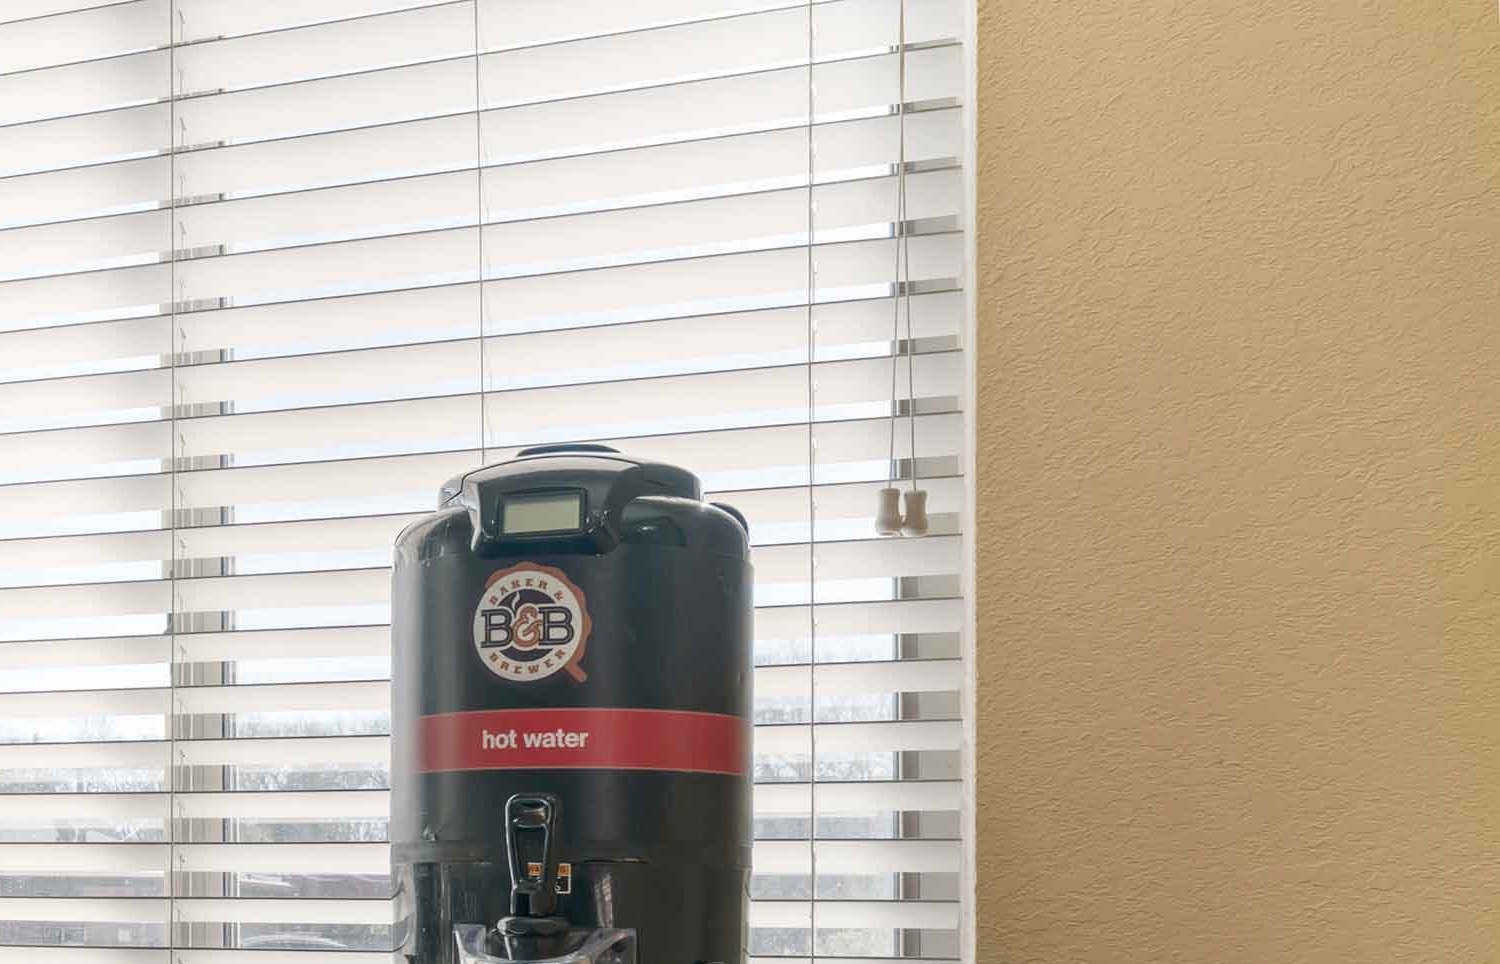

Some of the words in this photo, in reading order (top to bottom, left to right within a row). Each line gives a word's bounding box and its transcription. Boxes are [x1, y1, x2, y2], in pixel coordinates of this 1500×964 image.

[481, 606, 574, 648] B&B
[482, 729, 518, 750] hot
[523, 728, 589, 749] water
